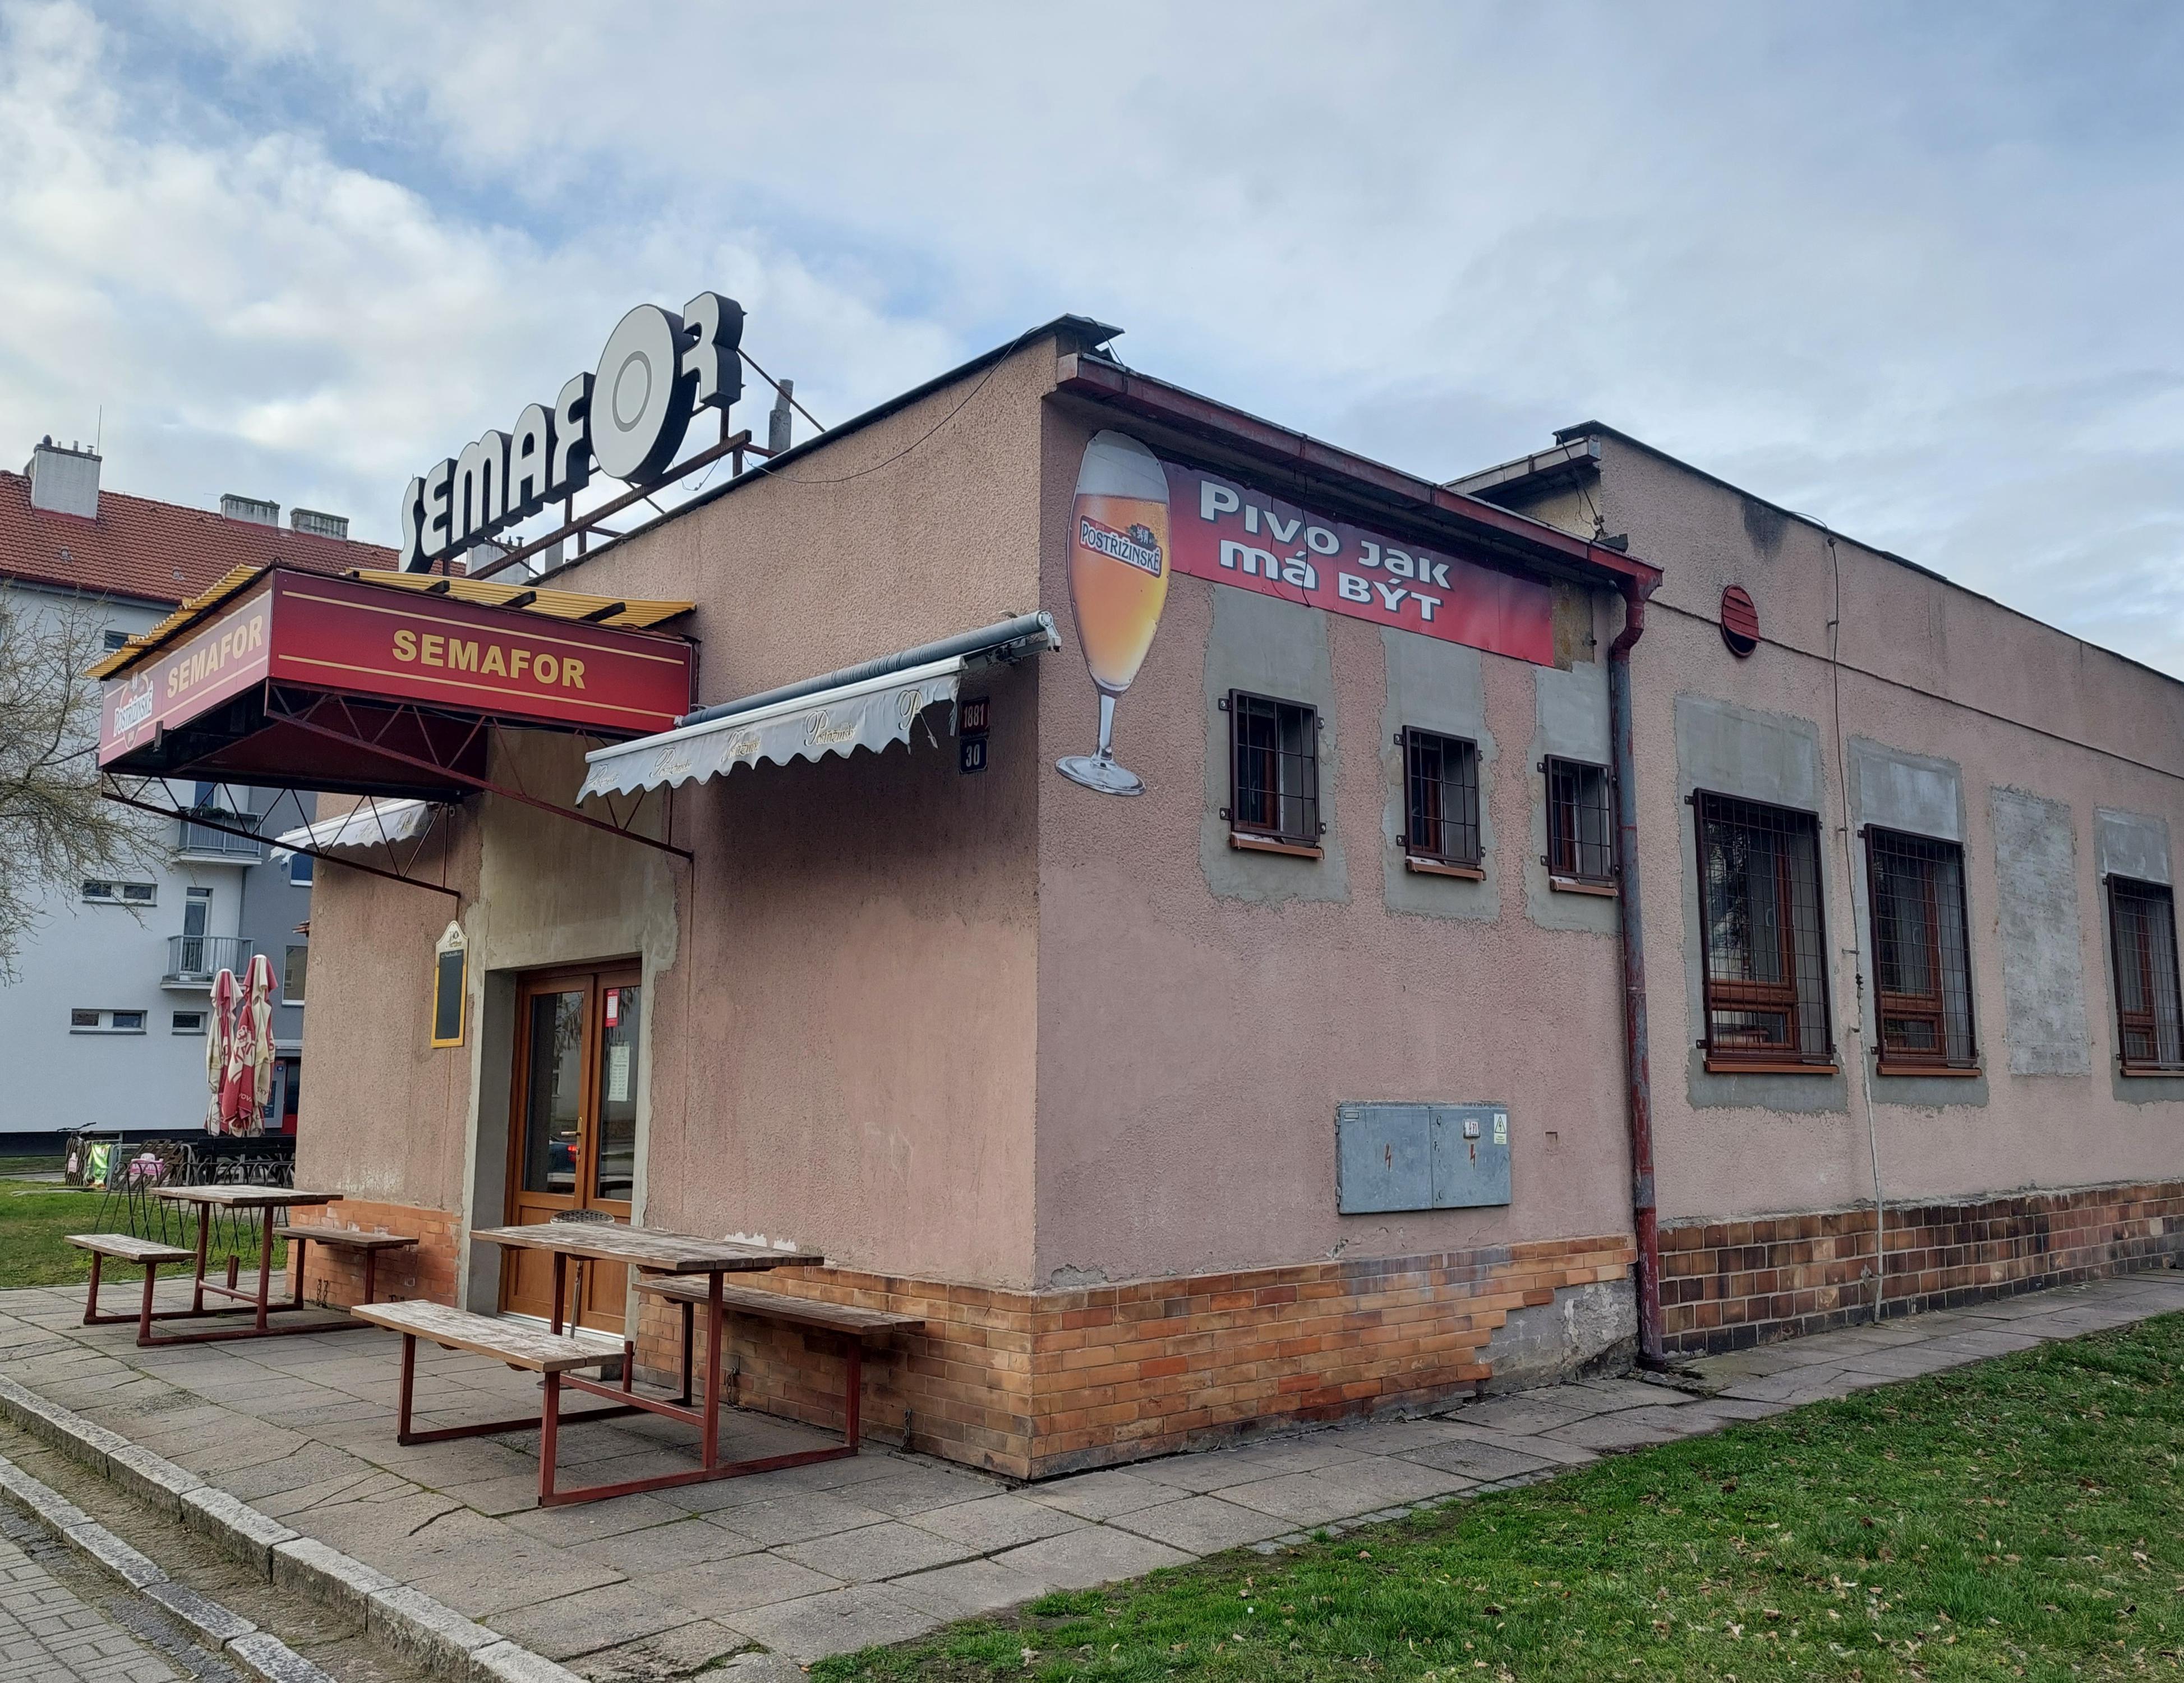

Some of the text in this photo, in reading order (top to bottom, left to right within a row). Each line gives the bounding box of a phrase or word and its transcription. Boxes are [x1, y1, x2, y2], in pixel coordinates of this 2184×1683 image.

[399, 291, 731, 573] SEMAFOR
[1082, 523, 1159, 571] POSTŘIŽINSKÉ
[1220, 540, 1316, 590] má
[167, 615, 262, 698] SEMAFOR
[392, 629, 586, 689] SEMAFOR
[964, 703, 984, 728] 1881
[966, 744, 980, 767] 30
